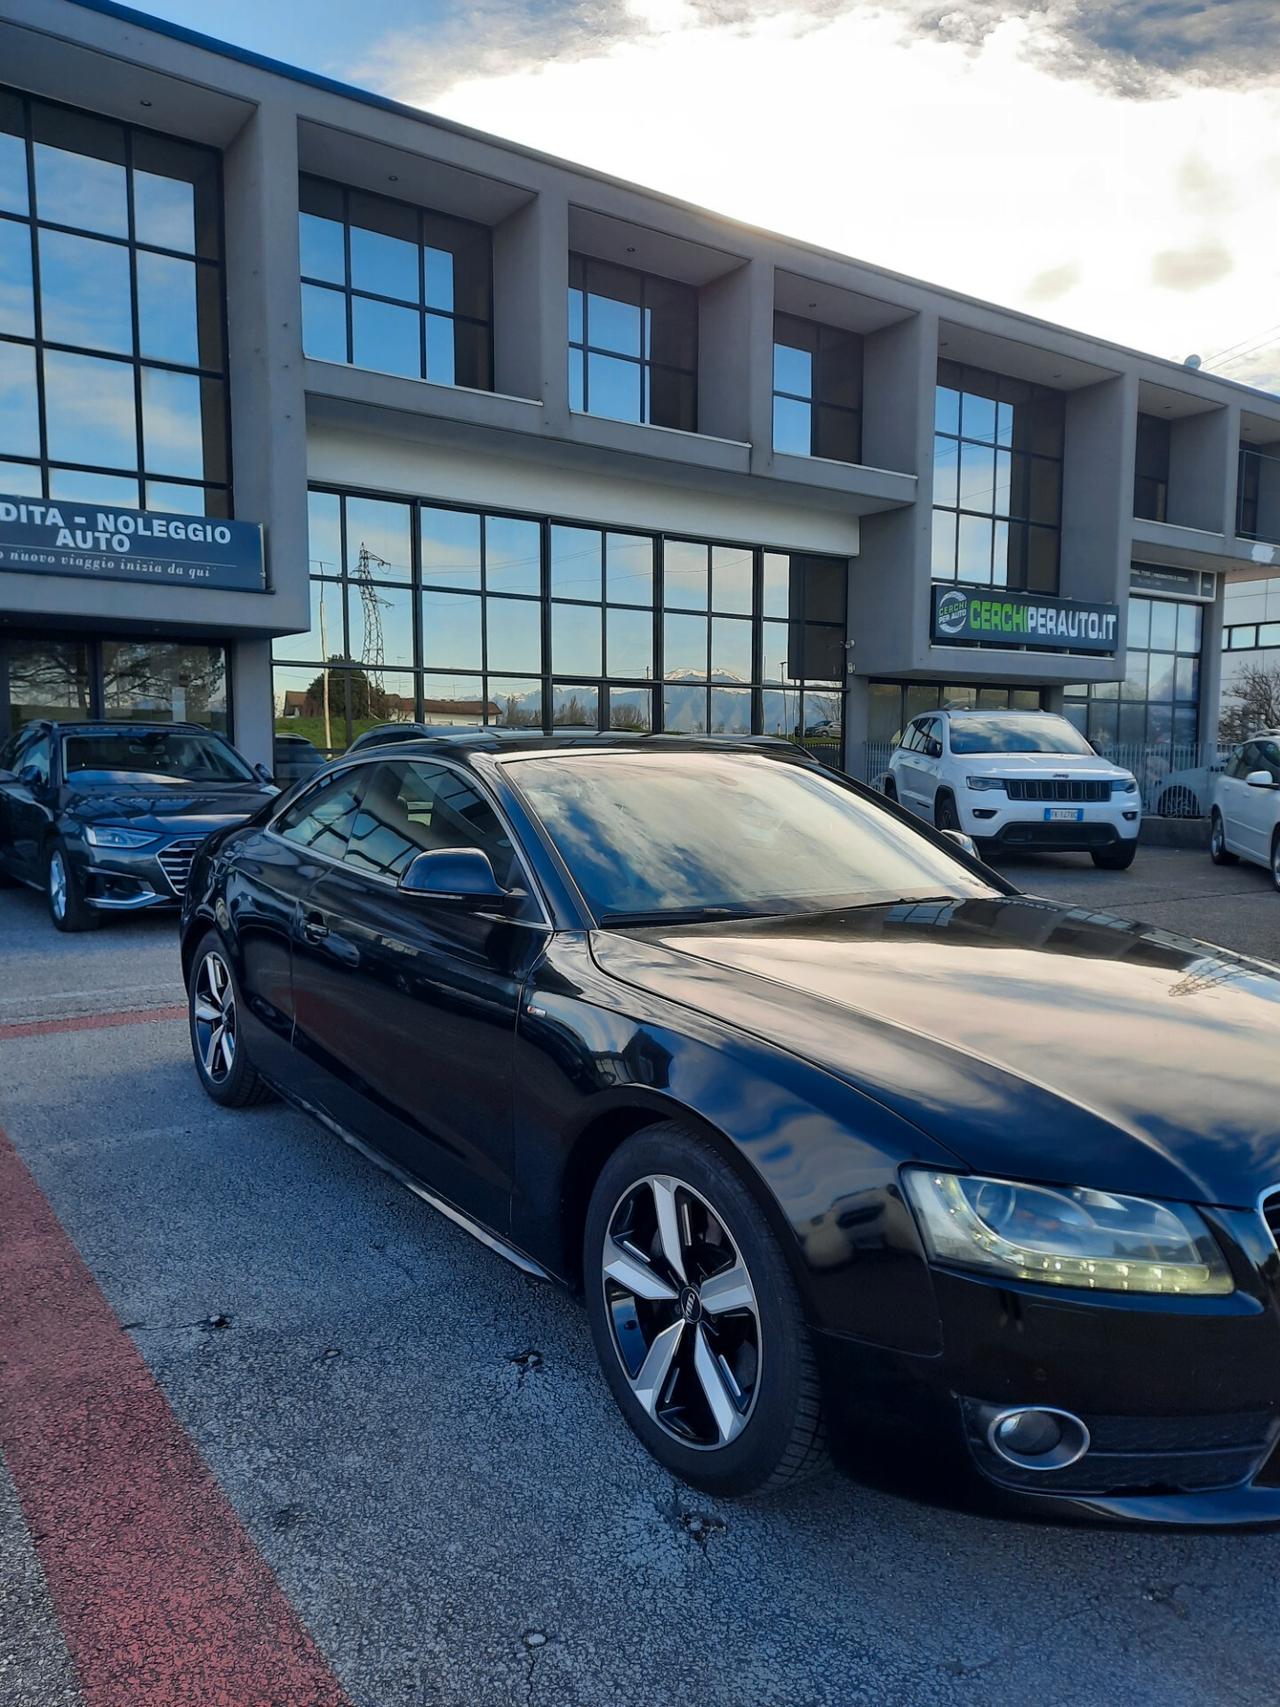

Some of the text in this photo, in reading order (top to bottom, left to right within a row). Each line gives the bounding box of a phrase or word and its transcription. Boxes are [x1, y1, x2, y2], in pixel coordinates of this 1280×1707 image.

[0, 502, 65, 527] DITA
[96, 513, 231, 544] NOLEGGIO
[56, 528, 130, 552] AUTO
[10, 551, 56, 563] nuovo
[61, 554, 115, 571] viaggio
[120, 559, 162, 573] inizia
[167, 563, 184, 575] da
[188, 567, 211, 579] qui
[938, 600, 968, 617] CERCHI
[969, 599, 1117, 640] CERCHIPERAUTO.IT
